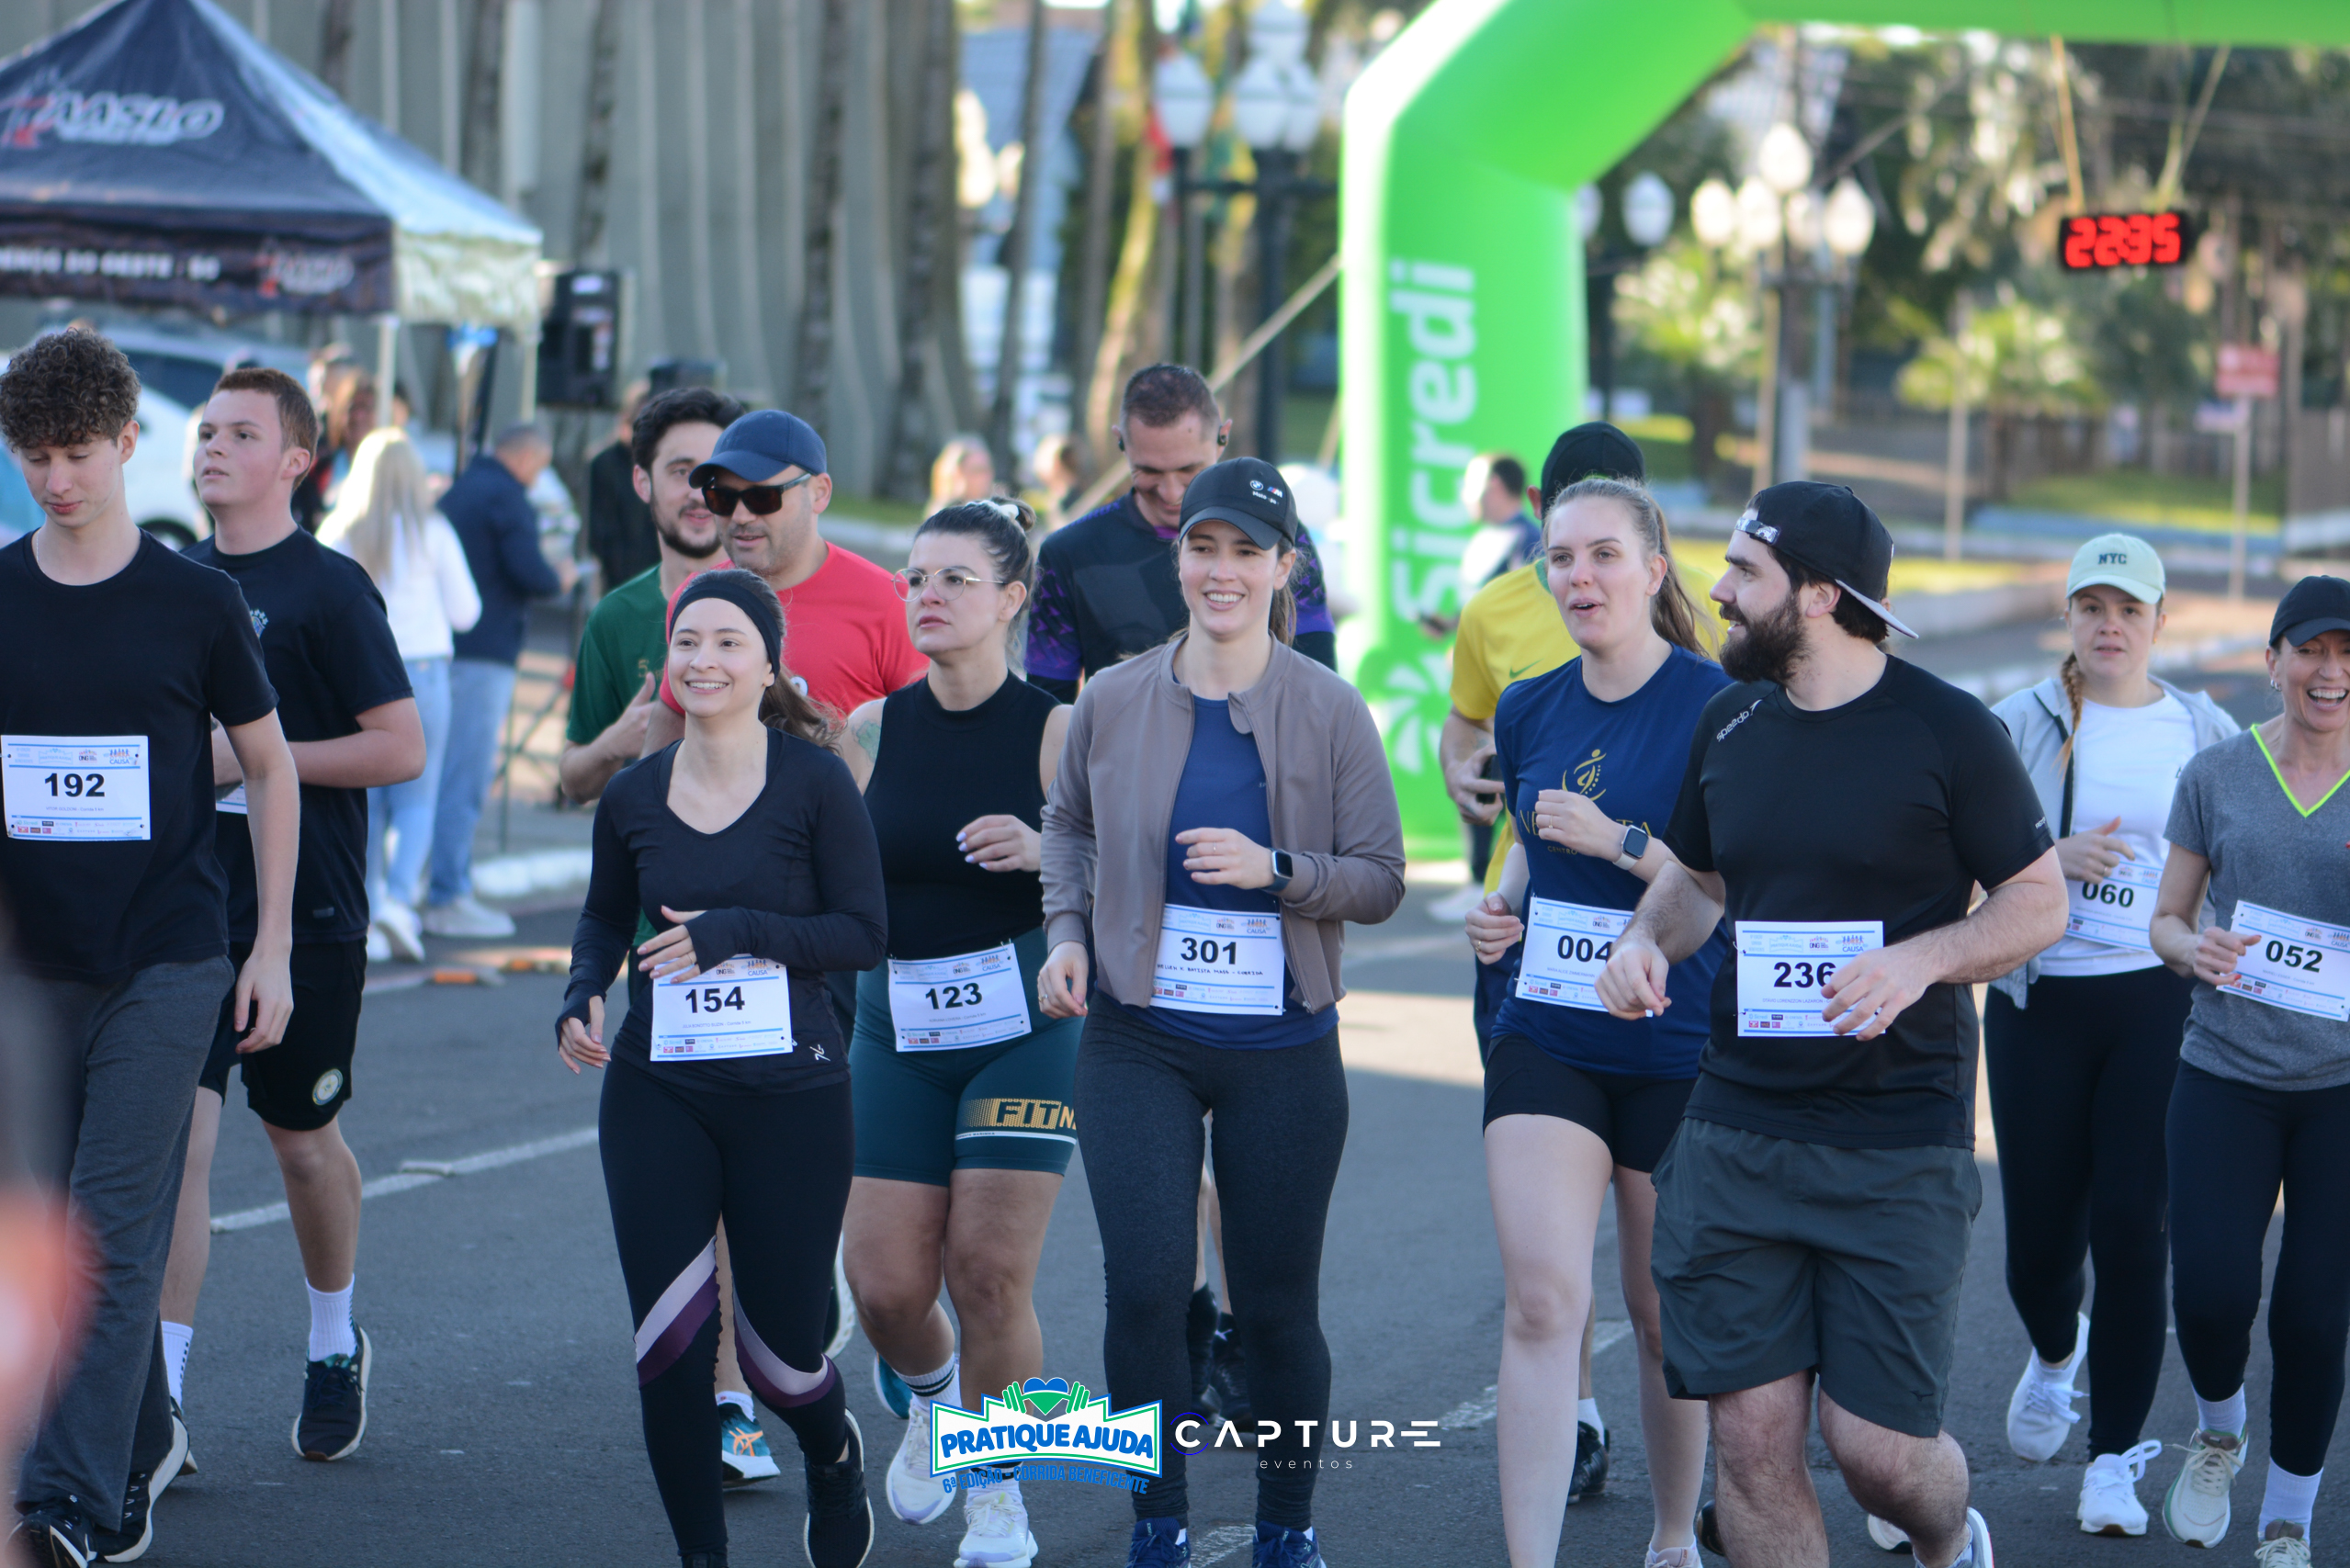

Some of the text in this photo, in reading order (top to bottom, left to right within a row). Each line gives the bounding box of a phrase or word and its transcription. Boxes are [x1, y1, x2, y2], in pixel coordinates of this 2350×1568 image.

[1391, 258, 1475, 623] Sicredi
[2097, 553, 2127, 565] NYC
[1716, 710, 1750, 742] speedo
[44, 773, 106, 797] 192
[1547, 846, 1578, 855] CENTRO
[2081, 882, 2134, 908] 060
[1180, 937, 1237, 965] 301
[1557, 935, 1612, 963] 004
[2265, 940, 2323, 973] 052
[1773, 962, 1836, 988] 236
[685, 986, 746, 1013] 154
[925, 982, 983, 1010] 123
